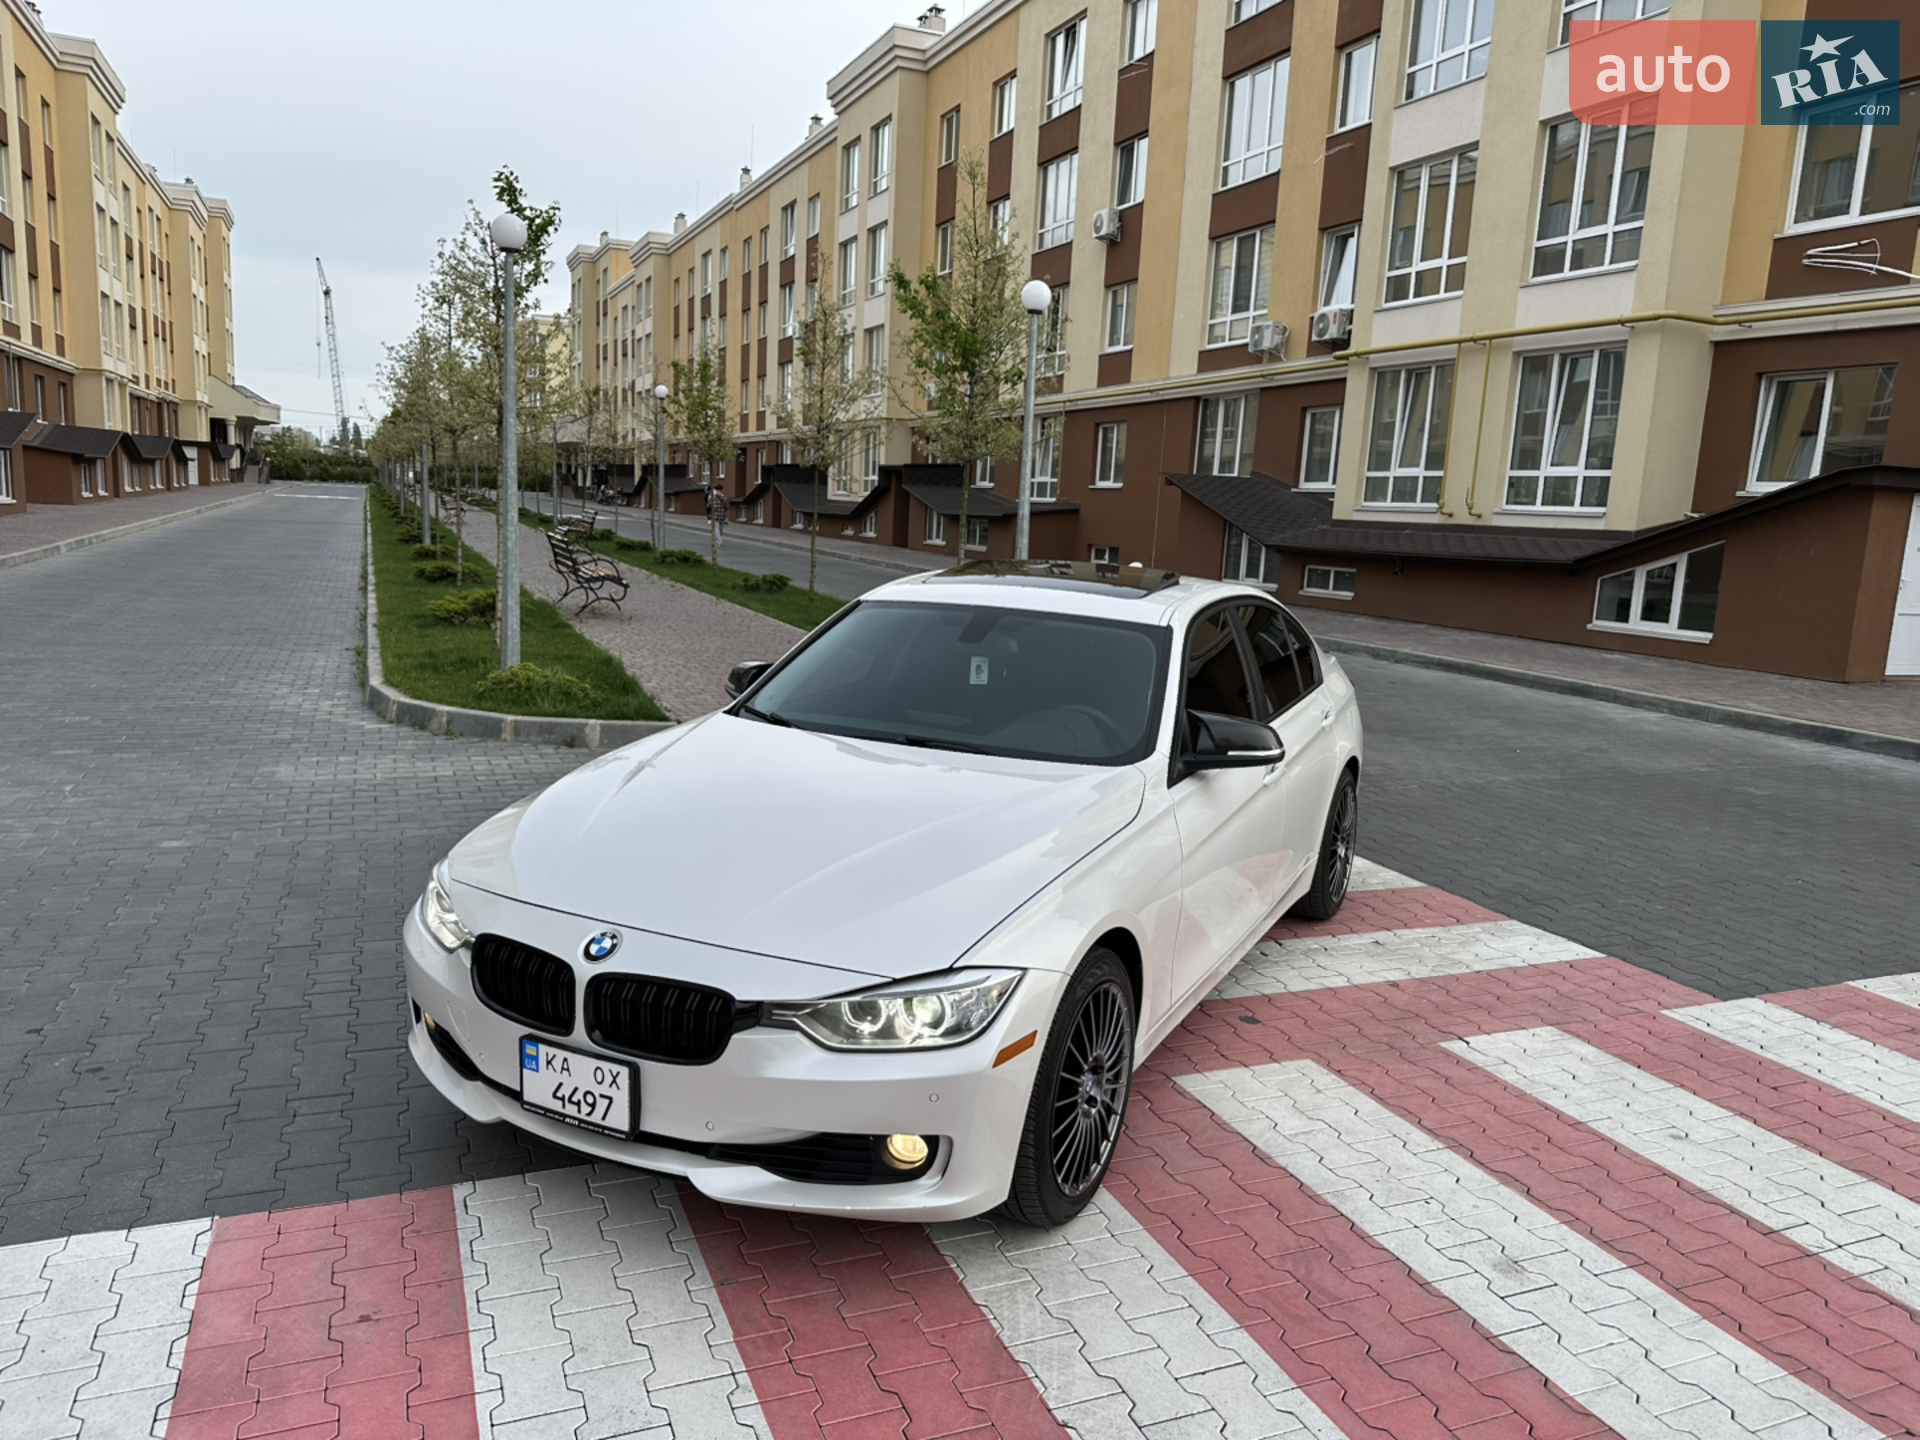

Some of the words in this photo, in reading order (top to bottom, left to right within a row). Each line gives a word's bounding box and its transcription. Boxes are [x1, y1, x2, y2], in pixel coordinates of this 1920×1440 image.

[525, 1057, 537, 1071] UA
[546, 1051, 571, 1077] KA
[593, 1066, 620, 1090] OX
[552, 1081, 613, 1121] 4497
